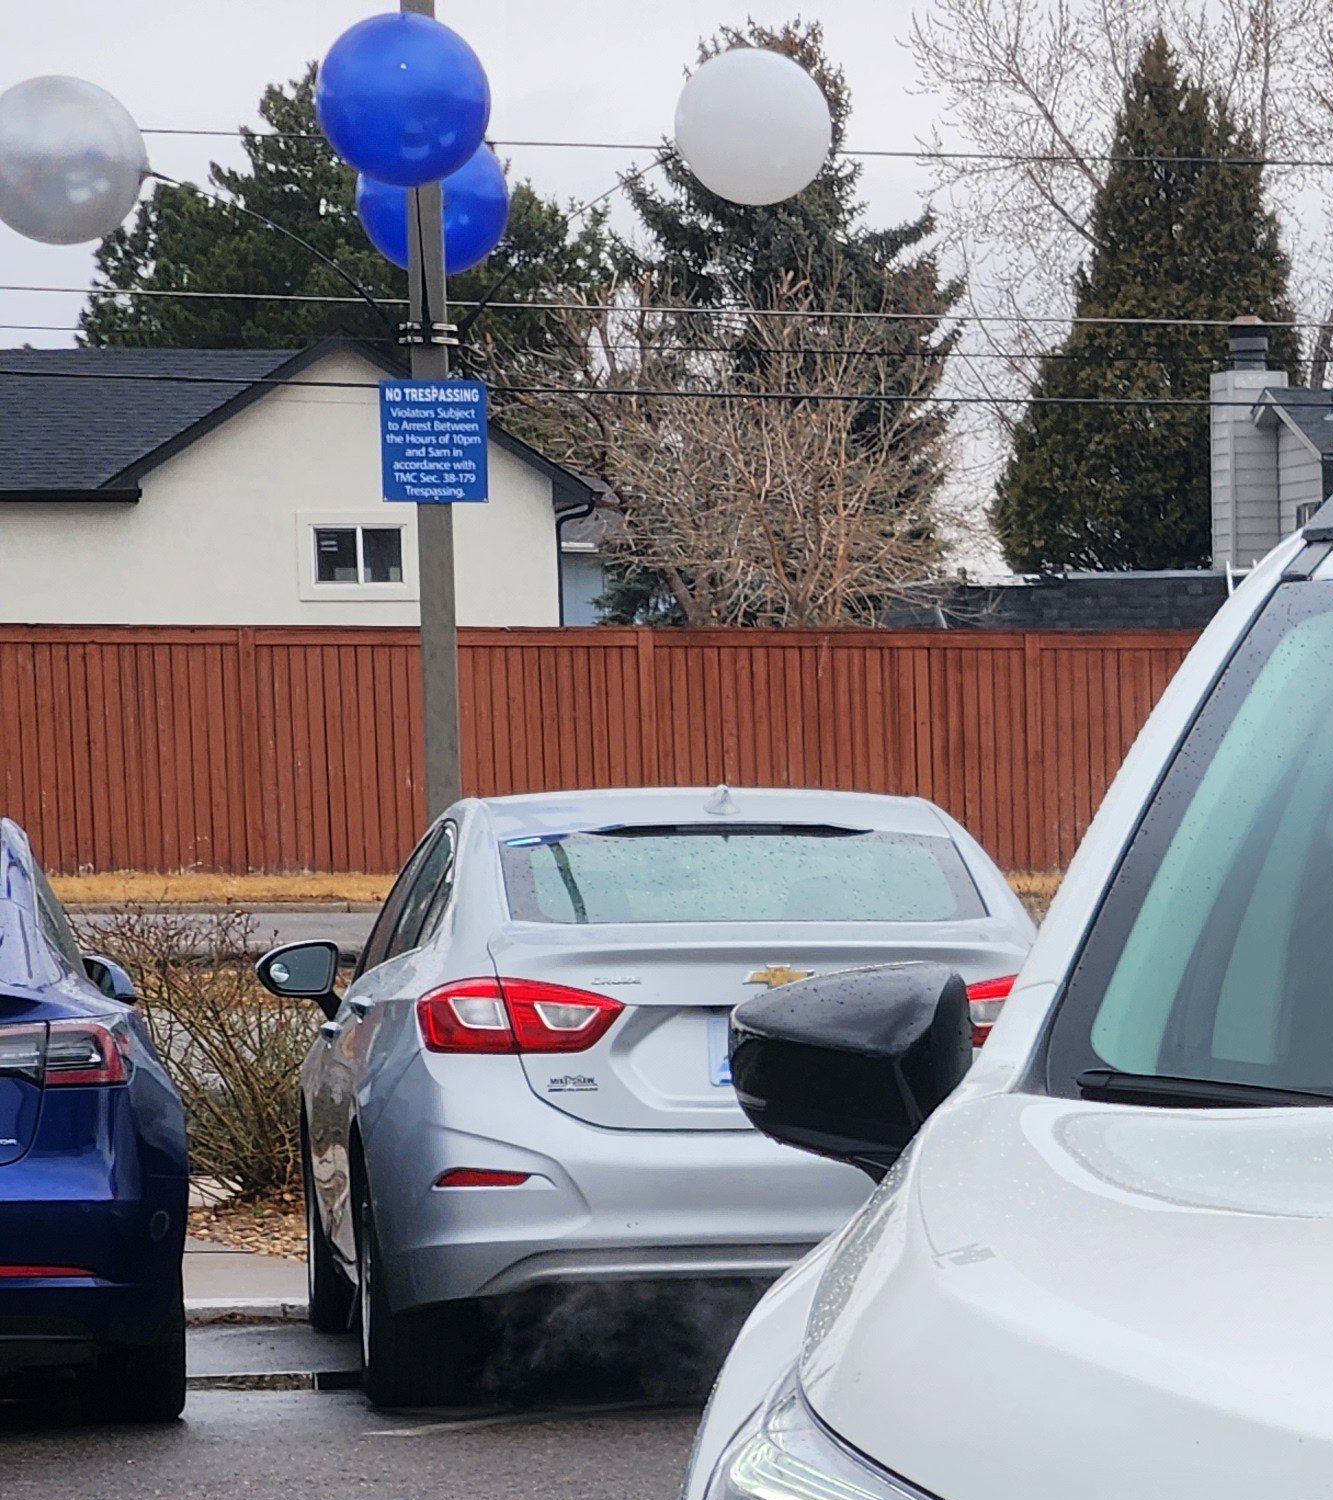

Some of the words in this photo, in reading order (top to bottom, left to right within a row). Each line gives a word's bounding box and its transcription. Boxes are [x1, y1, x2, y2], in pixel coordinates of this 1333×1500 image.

[385, 387, 402, 402] NO
[404, 387, 480, 402] TRESPASSING
[390, 407, 435, 418] Violators
[437, 407, 475, 420] Subject
[388, 421, 399, 431] to
[401, 420, 432, 431] Arrest
[433, 420, 479, 431] Between
[386, 434, 404, 444] the
[405, 434, 437, 444] Hours
[438, 434, 450, 444] of
[452, 434, 481, 446] 10pm
[405, 446, 426, 457] and
[452, 447, 463, 457] in
[392, 459, 451, 470] accordance
[452, 459, 476, 470] with
[393, 472, 418, 483] TMC
